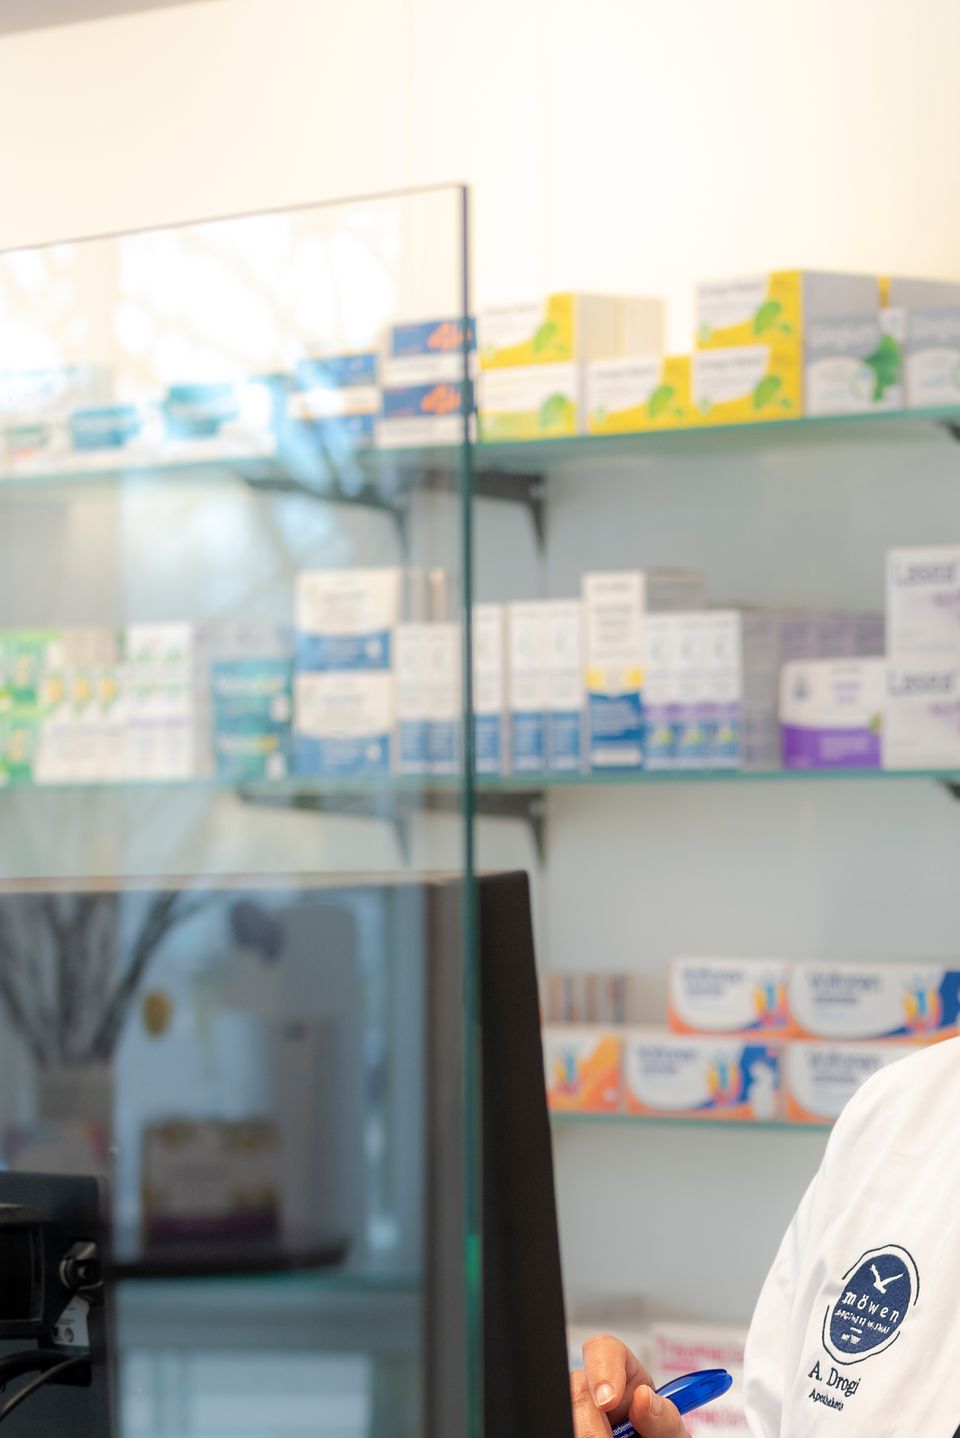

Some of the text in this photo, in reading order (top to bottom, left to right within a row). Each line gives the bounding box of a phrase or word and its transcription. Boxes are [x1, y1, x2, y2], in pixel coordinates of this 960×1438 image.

[842, 1291, 900, 1324] möwen
[808, 1360, 861, 1398] A. Drogi
